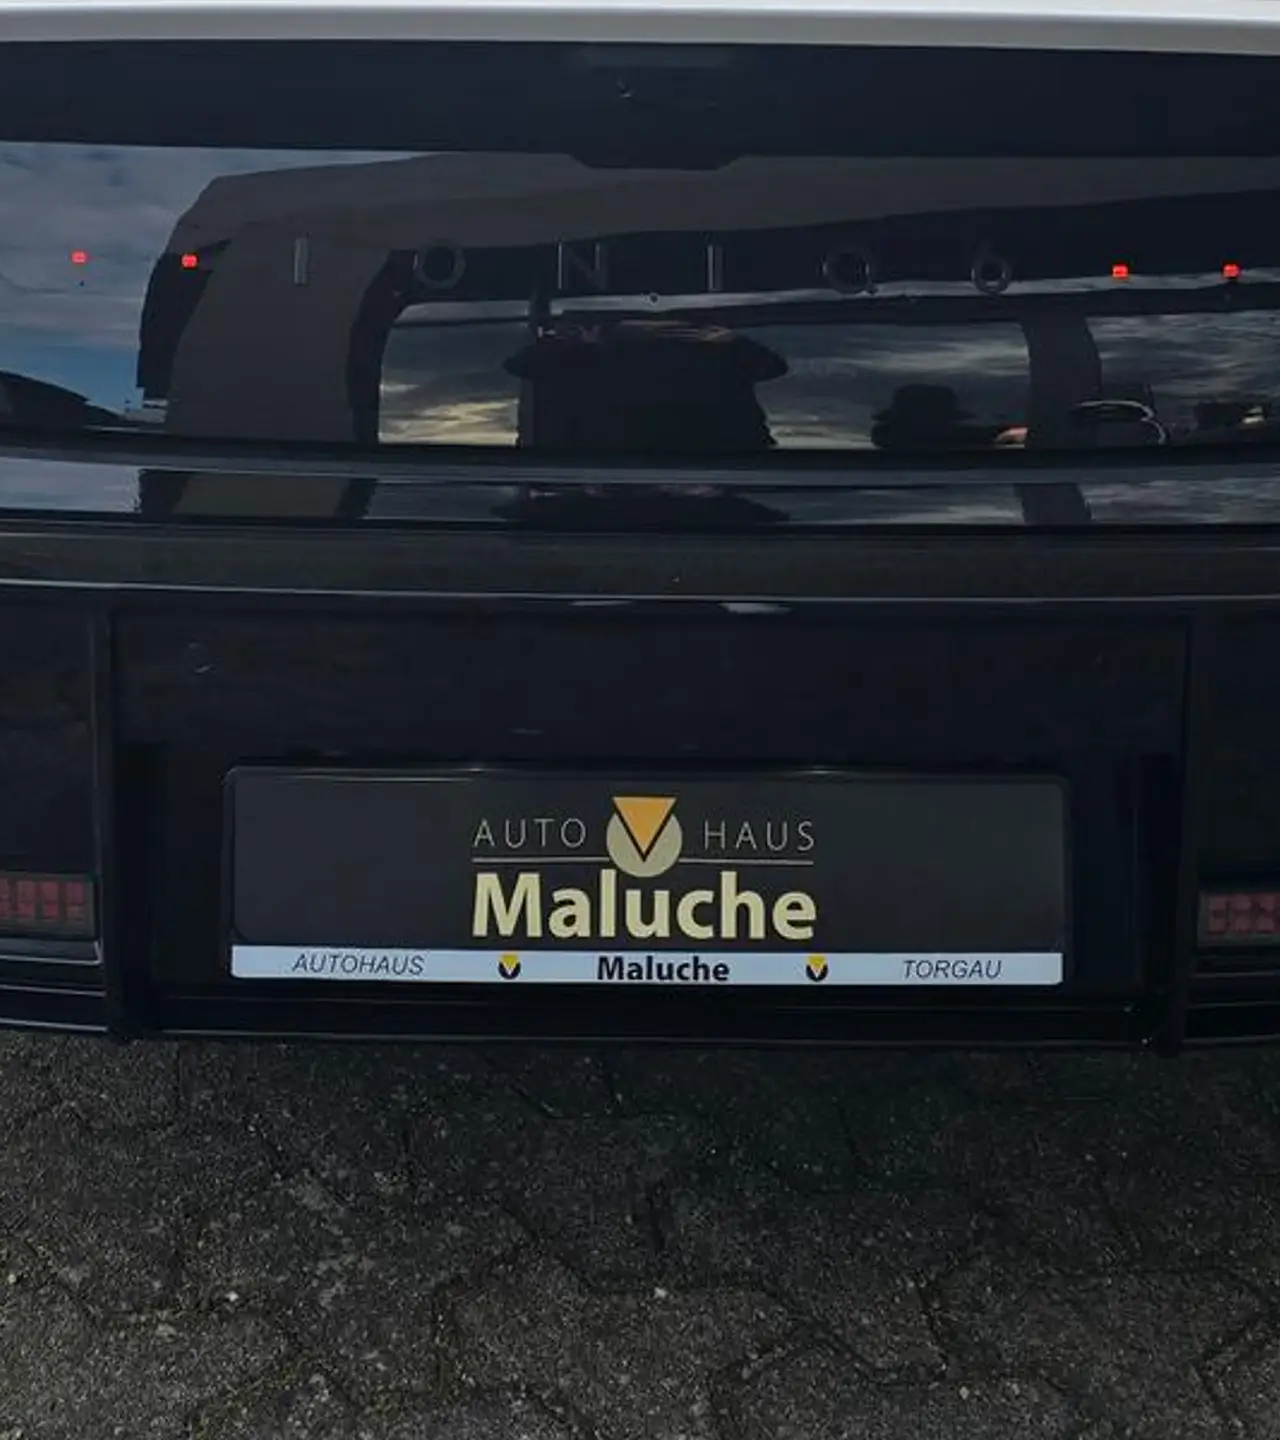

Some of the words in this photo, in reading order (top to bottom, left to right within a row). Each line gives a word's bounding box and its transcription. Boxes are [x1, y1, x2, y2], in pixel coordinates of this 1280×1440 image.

[293, 237, 878, 295] IONIQ
[473, 817, 586, 849] AUTO
[703, 820, 815, 852] HAUS
[472, 869, 817, 940] Maluche
[291, 953, 424, 976] AUTOHAUS
[597, 955, 729, 982] Maluche
[903, 960, 1002, 980] TORGAU
